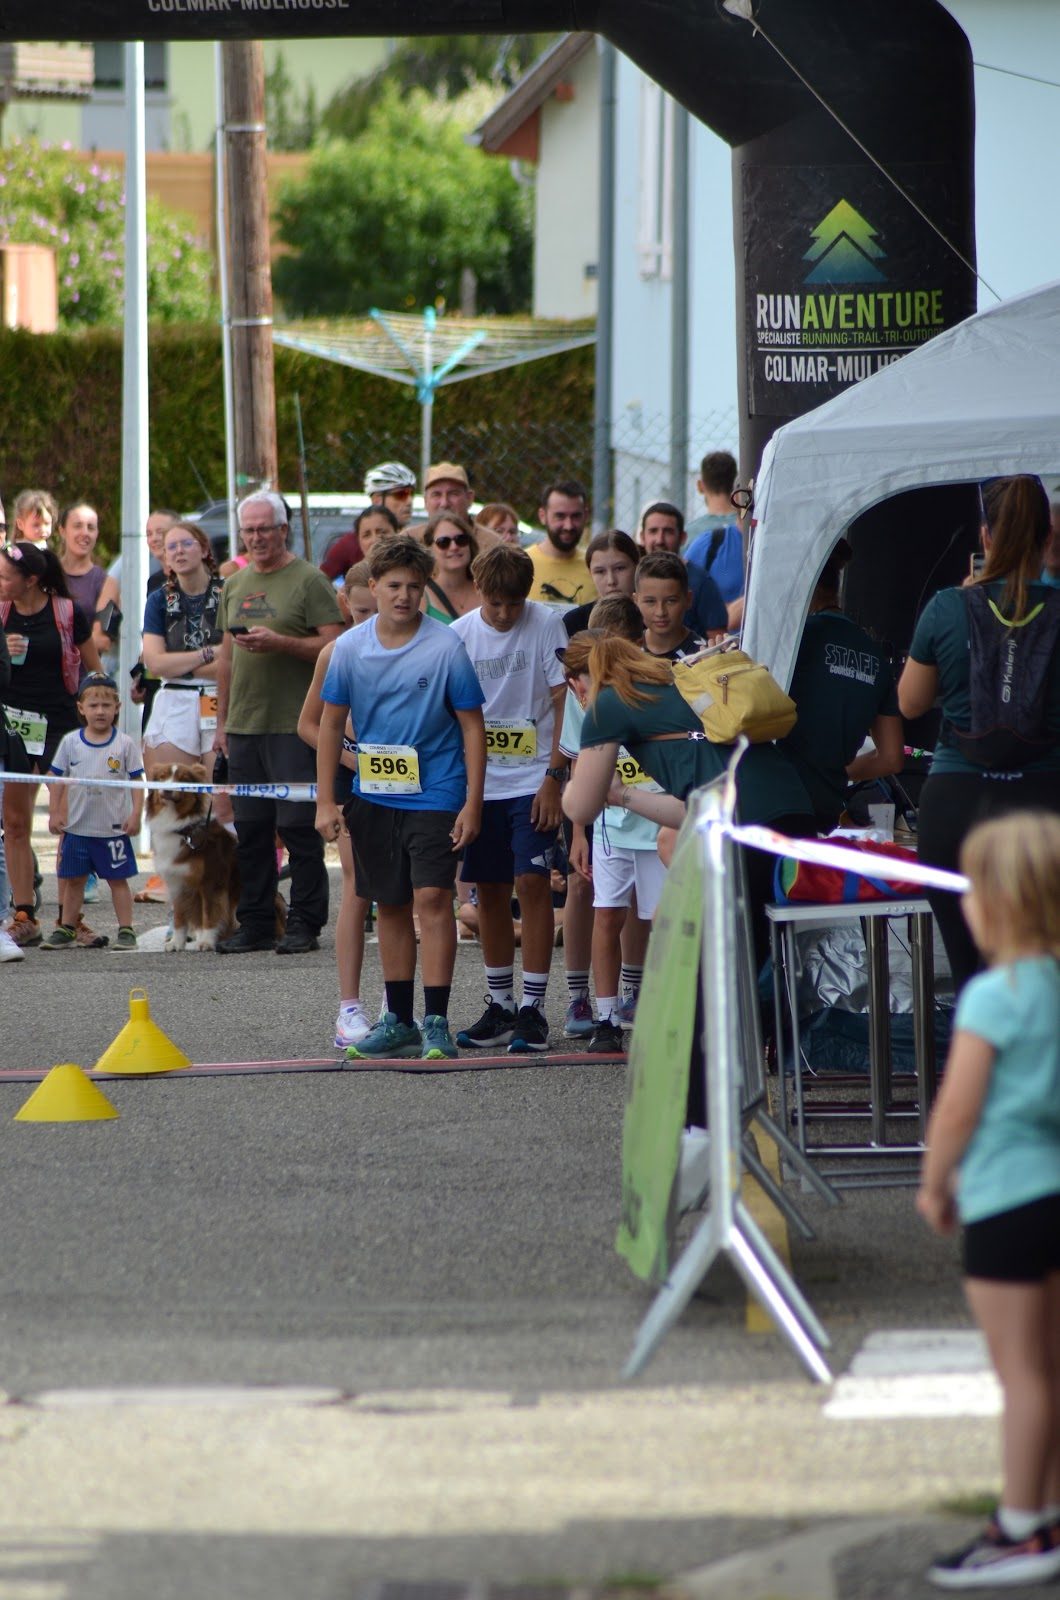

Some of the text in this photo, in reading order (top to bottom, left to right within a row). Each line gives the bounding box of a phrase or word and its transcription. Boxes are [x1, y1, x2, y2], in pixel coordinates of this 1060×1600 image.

[756, 290, 945, 329] RUNAVENTURE
[825, 643, 880, 676] STAFF
[1003, 639, 1017, 683] Kalenji
[486, 731, 524, 749] 597
[370, 757, 408, 775] 596
[107, 840, 128, 861] 12
